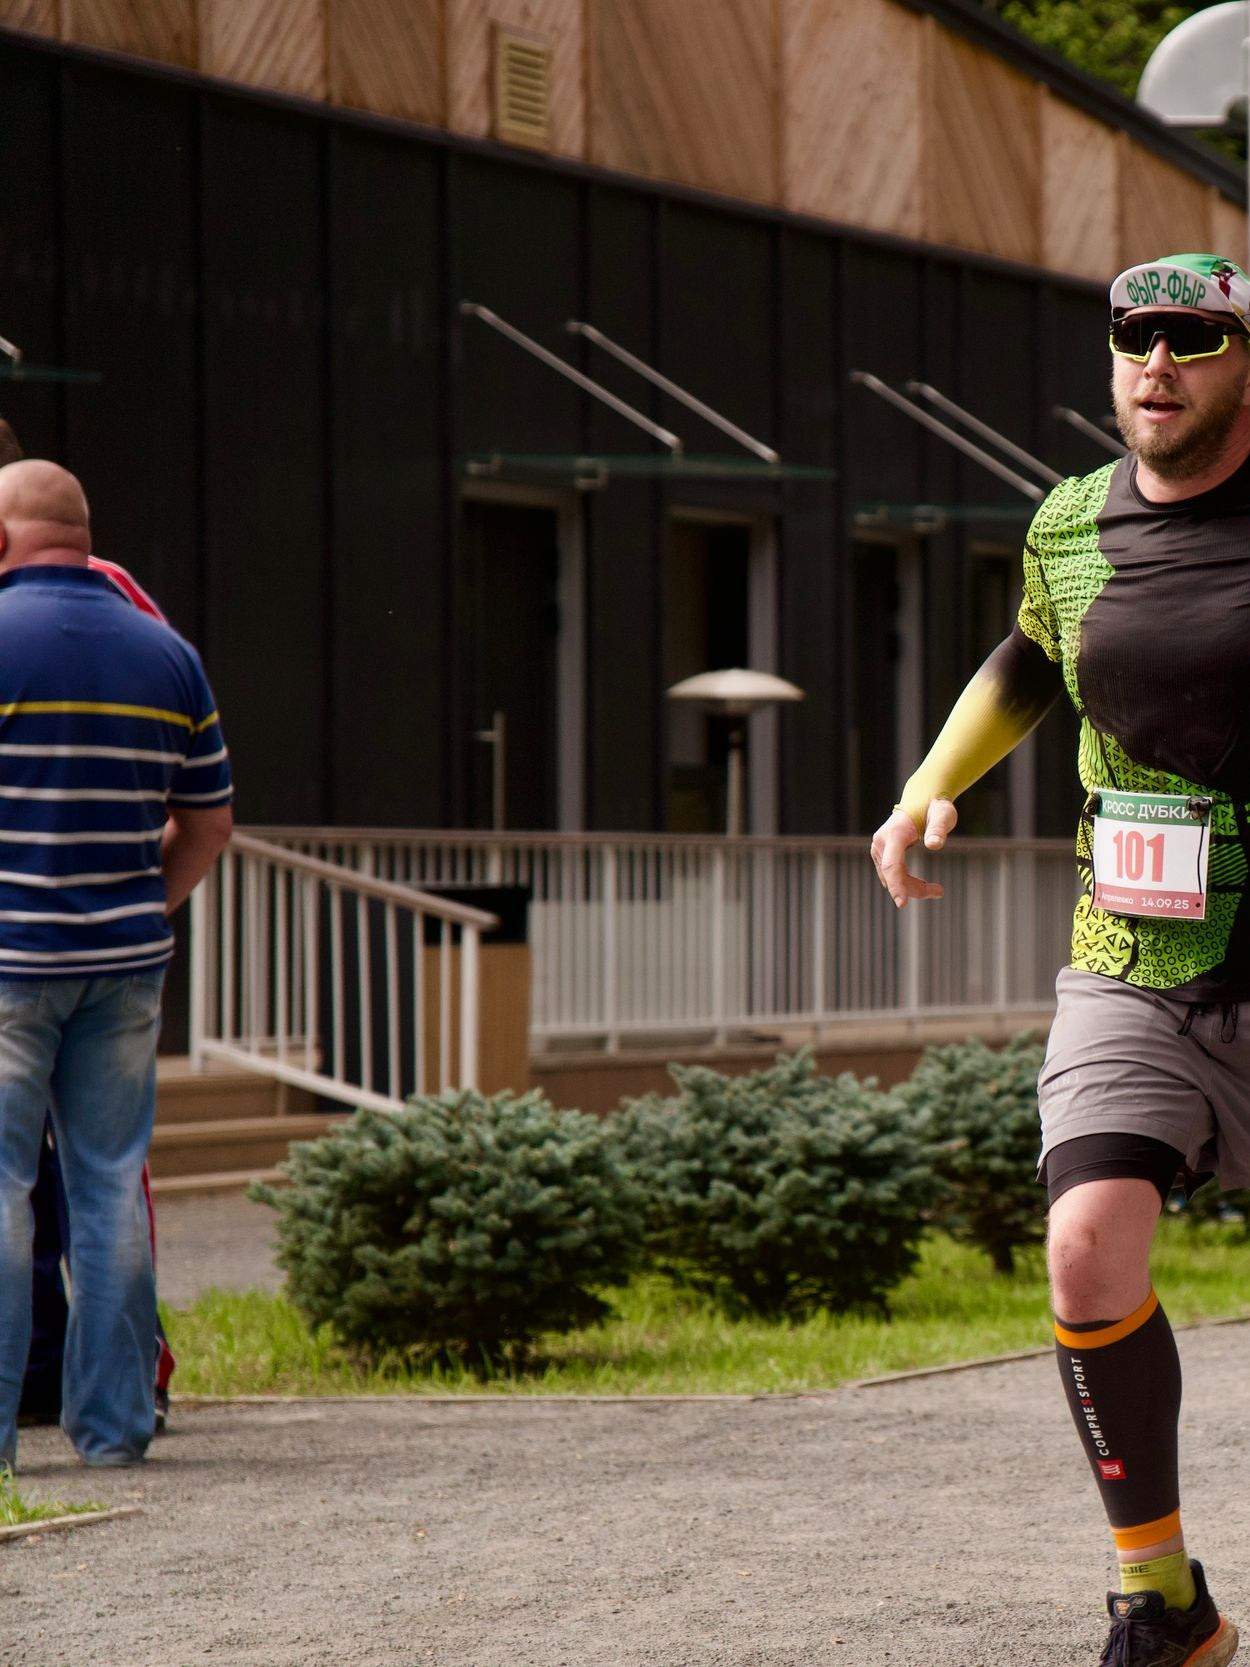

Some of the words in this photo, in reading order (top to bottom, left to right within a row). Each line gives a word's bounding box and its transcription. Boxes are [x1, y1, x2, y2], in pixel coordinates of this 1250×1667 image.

[1126, 270, 1206, 307] ФЫР-ФЫР
[1102, 799, 1135, 816] КРОСС
[1113, 830, 1165, 883] 101
[1141, 897, 1189, 910] 14.09.25
